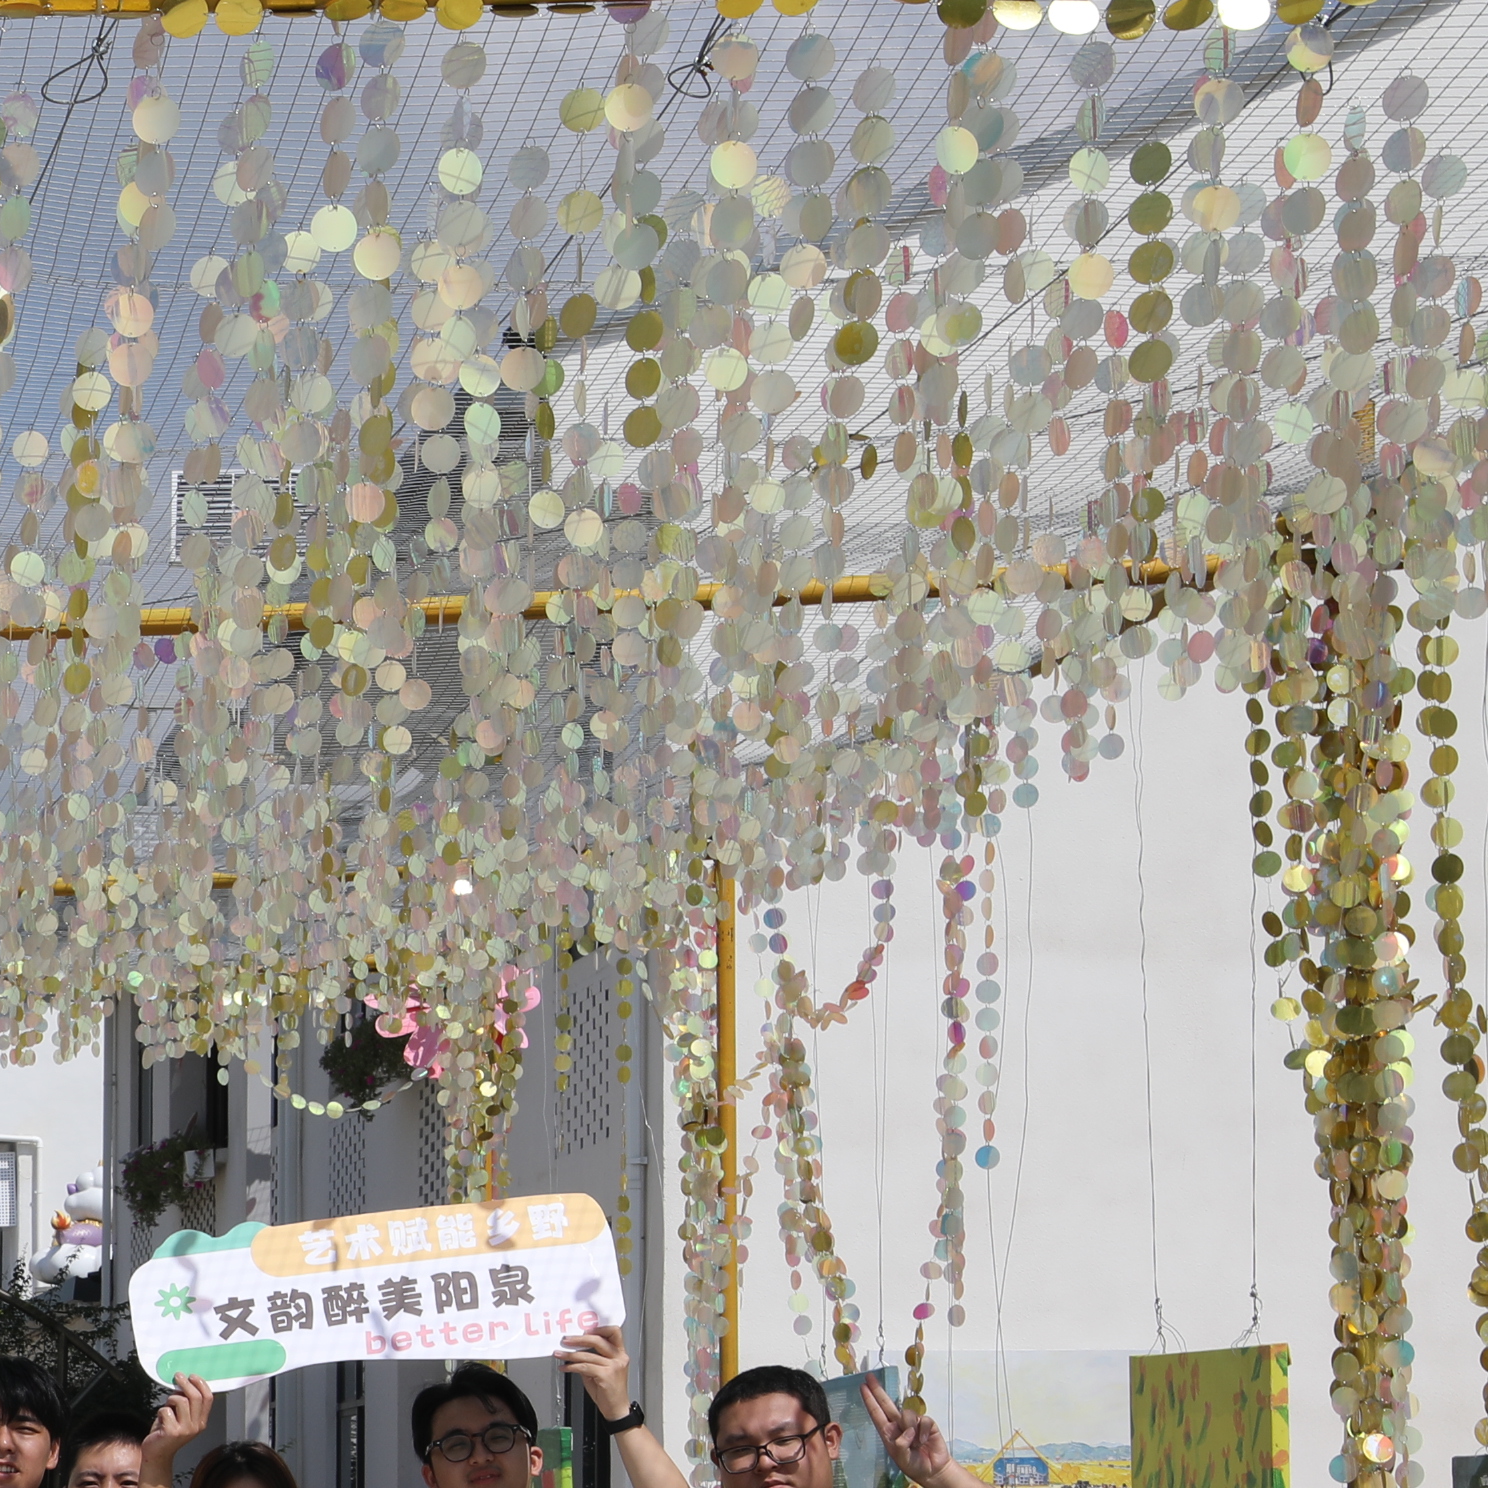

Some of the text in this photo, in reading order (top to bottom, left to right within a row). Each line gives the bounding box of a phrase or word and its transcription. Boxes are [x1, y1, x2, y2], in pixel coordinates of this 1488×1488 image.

[297, 1202, 568, 1266] 艺术赋能乡野
[213, 1263, 536, 1341] 文韵醉美阳泉
[365, 1308, 600, 1356] better life
